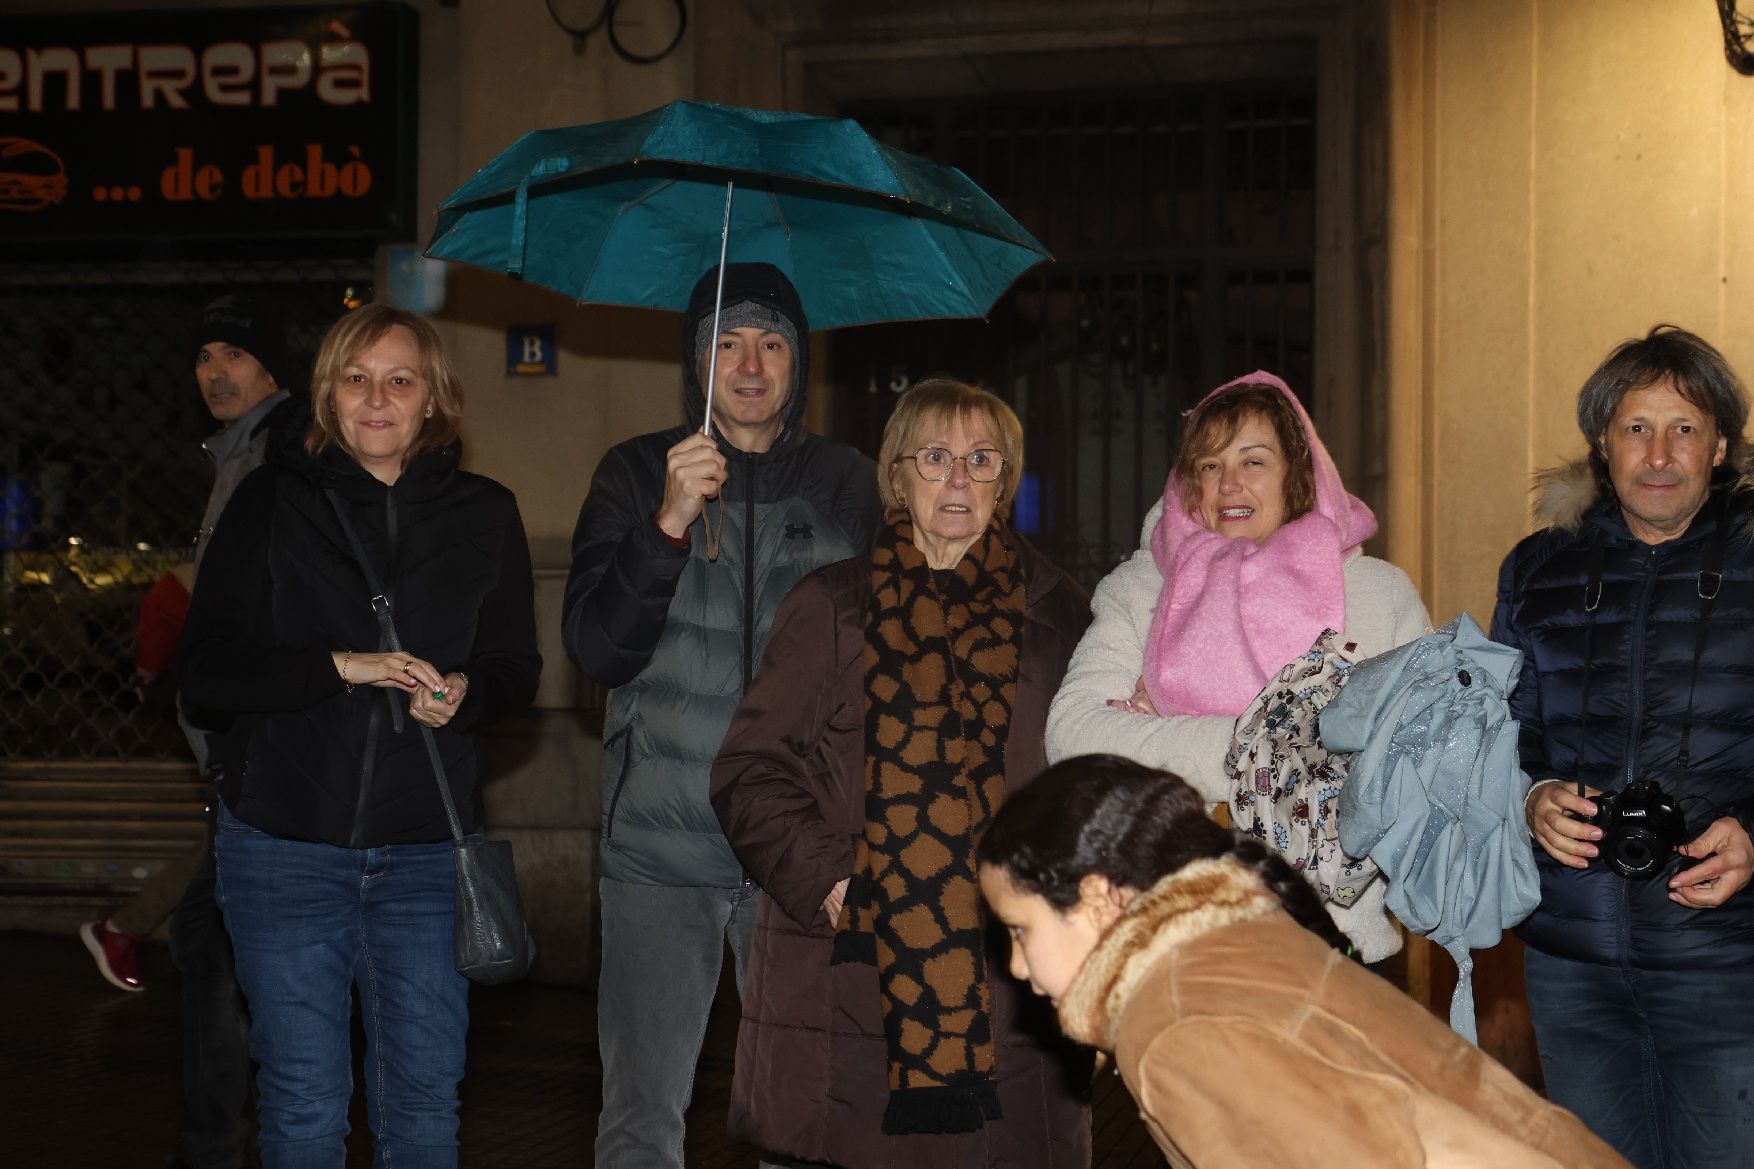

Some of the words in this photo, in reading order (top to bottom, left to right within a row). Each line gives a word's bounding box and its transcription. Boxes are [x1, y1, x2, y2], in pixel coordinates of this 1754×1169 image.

[160, 146, 225, 202] de
[240, 142, 373, 200] debò
[522, 335, 543, 363] B
[867, 364, 909, 393] 15
